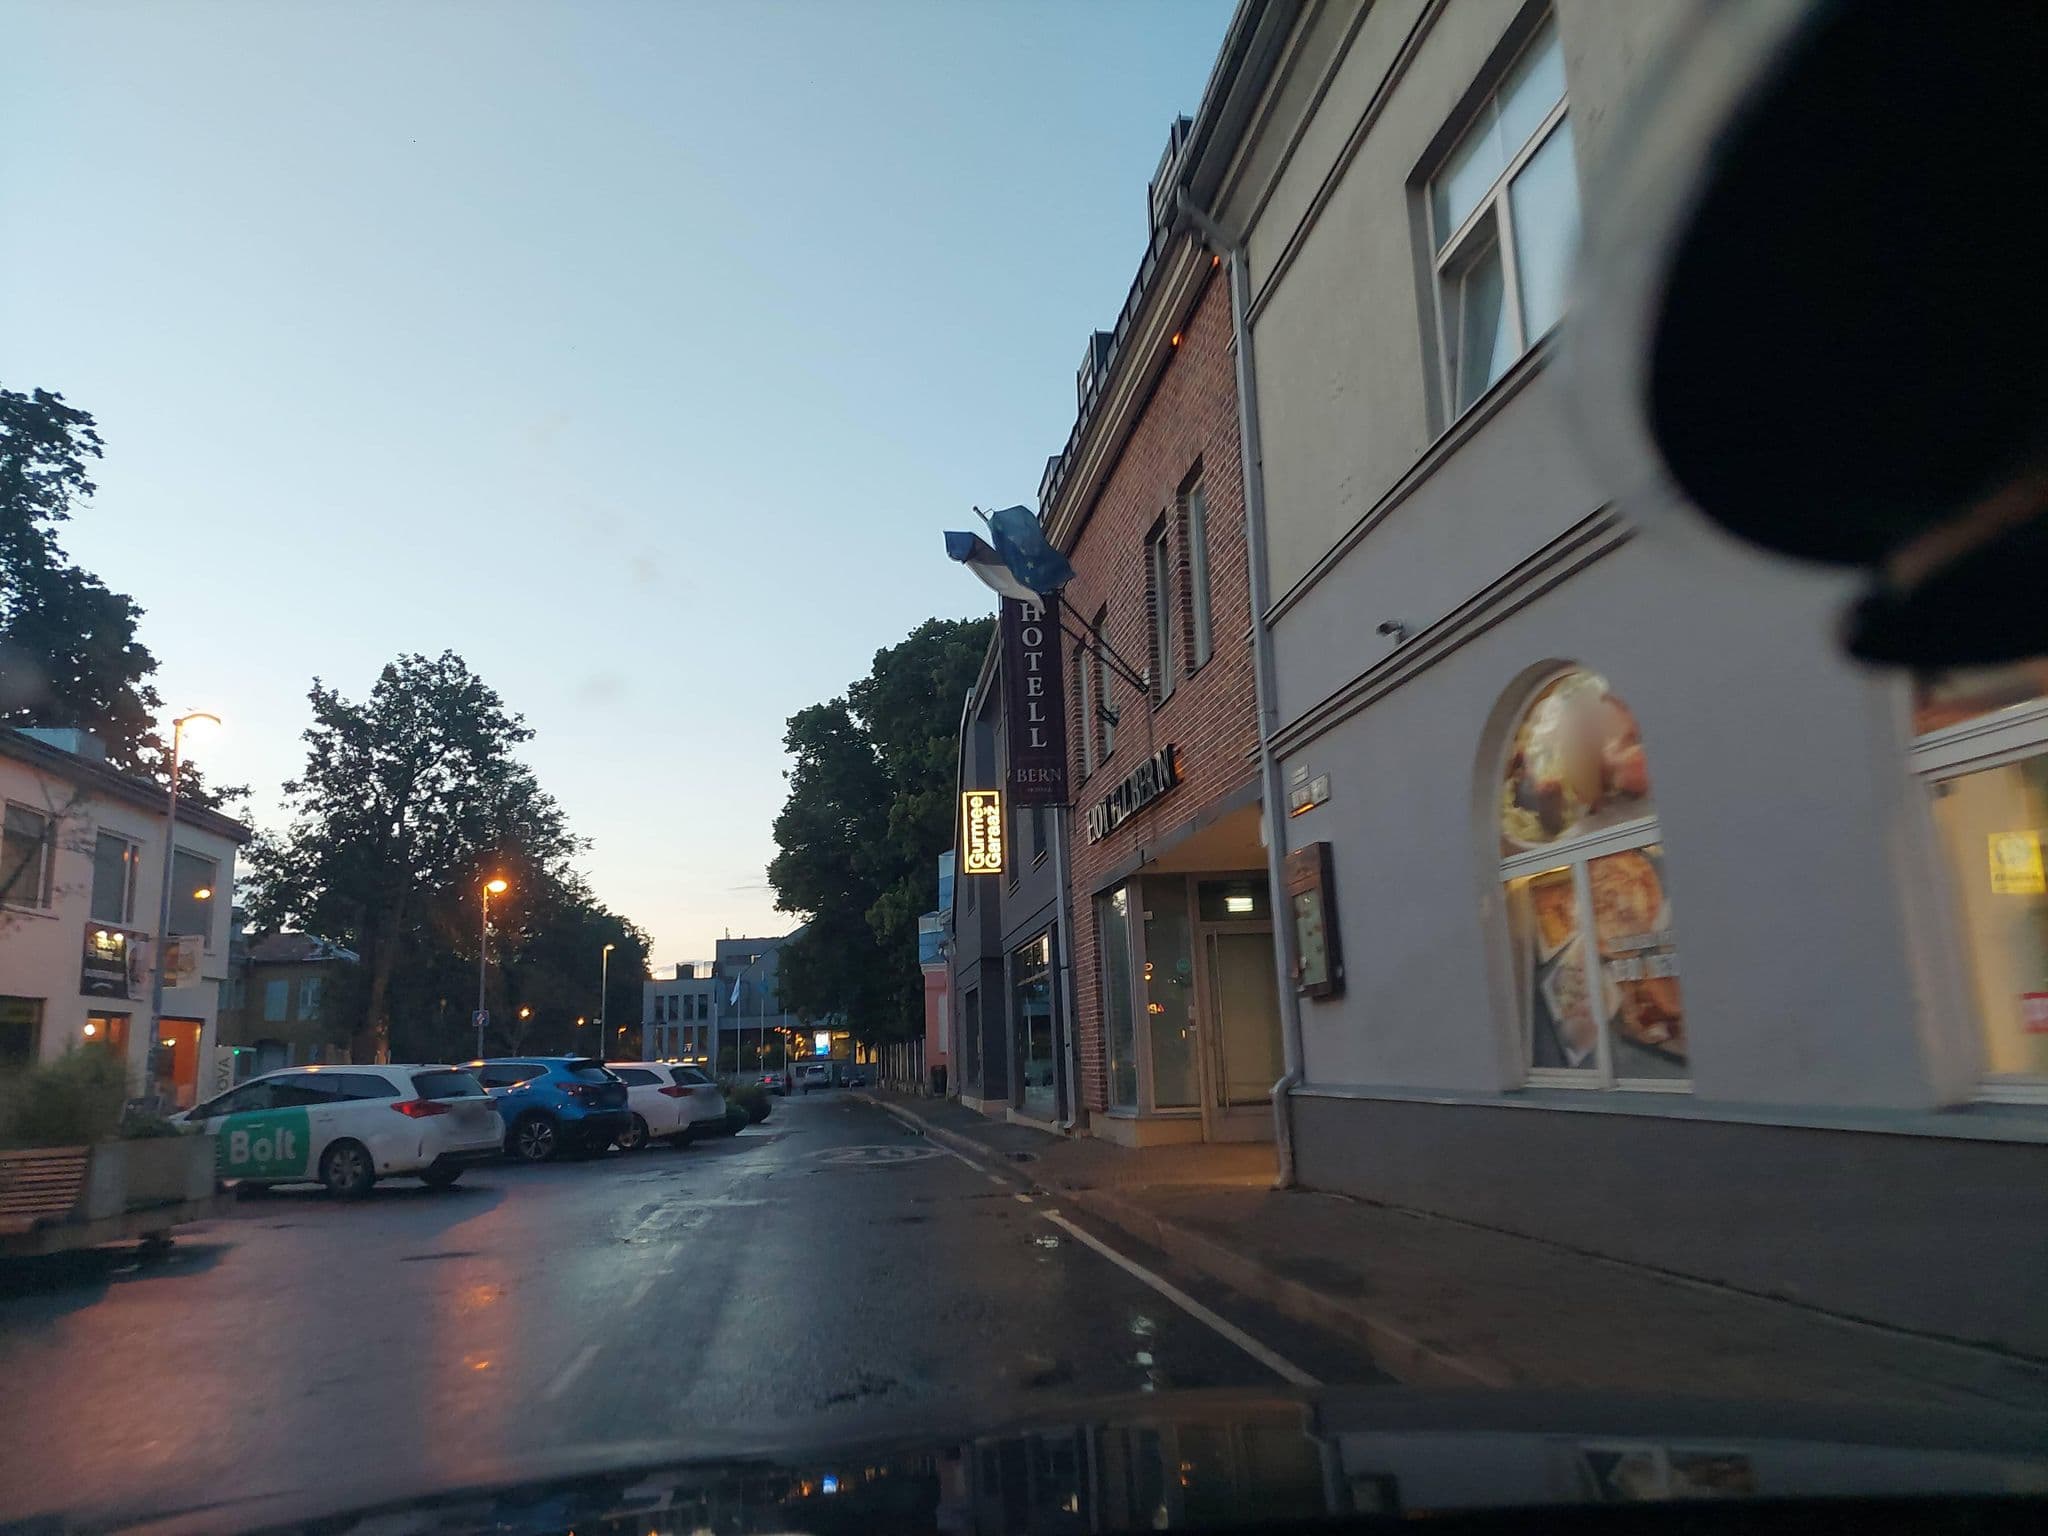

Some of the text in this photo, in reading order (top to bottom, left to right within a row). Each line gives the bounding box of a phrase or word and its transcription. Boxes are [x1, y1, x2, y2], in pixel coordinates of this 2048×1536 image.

[1019, 602, 1048, 748] HOTELL
[1016, 768, 1062, 783] BERN
[969, 796, 985, 869] Gurmee
[983, 805, 1002, 869] Garaaž
[1086, 783, 1132, 846] HOTEL
[230, 1127, 296, 1164] Bolt
